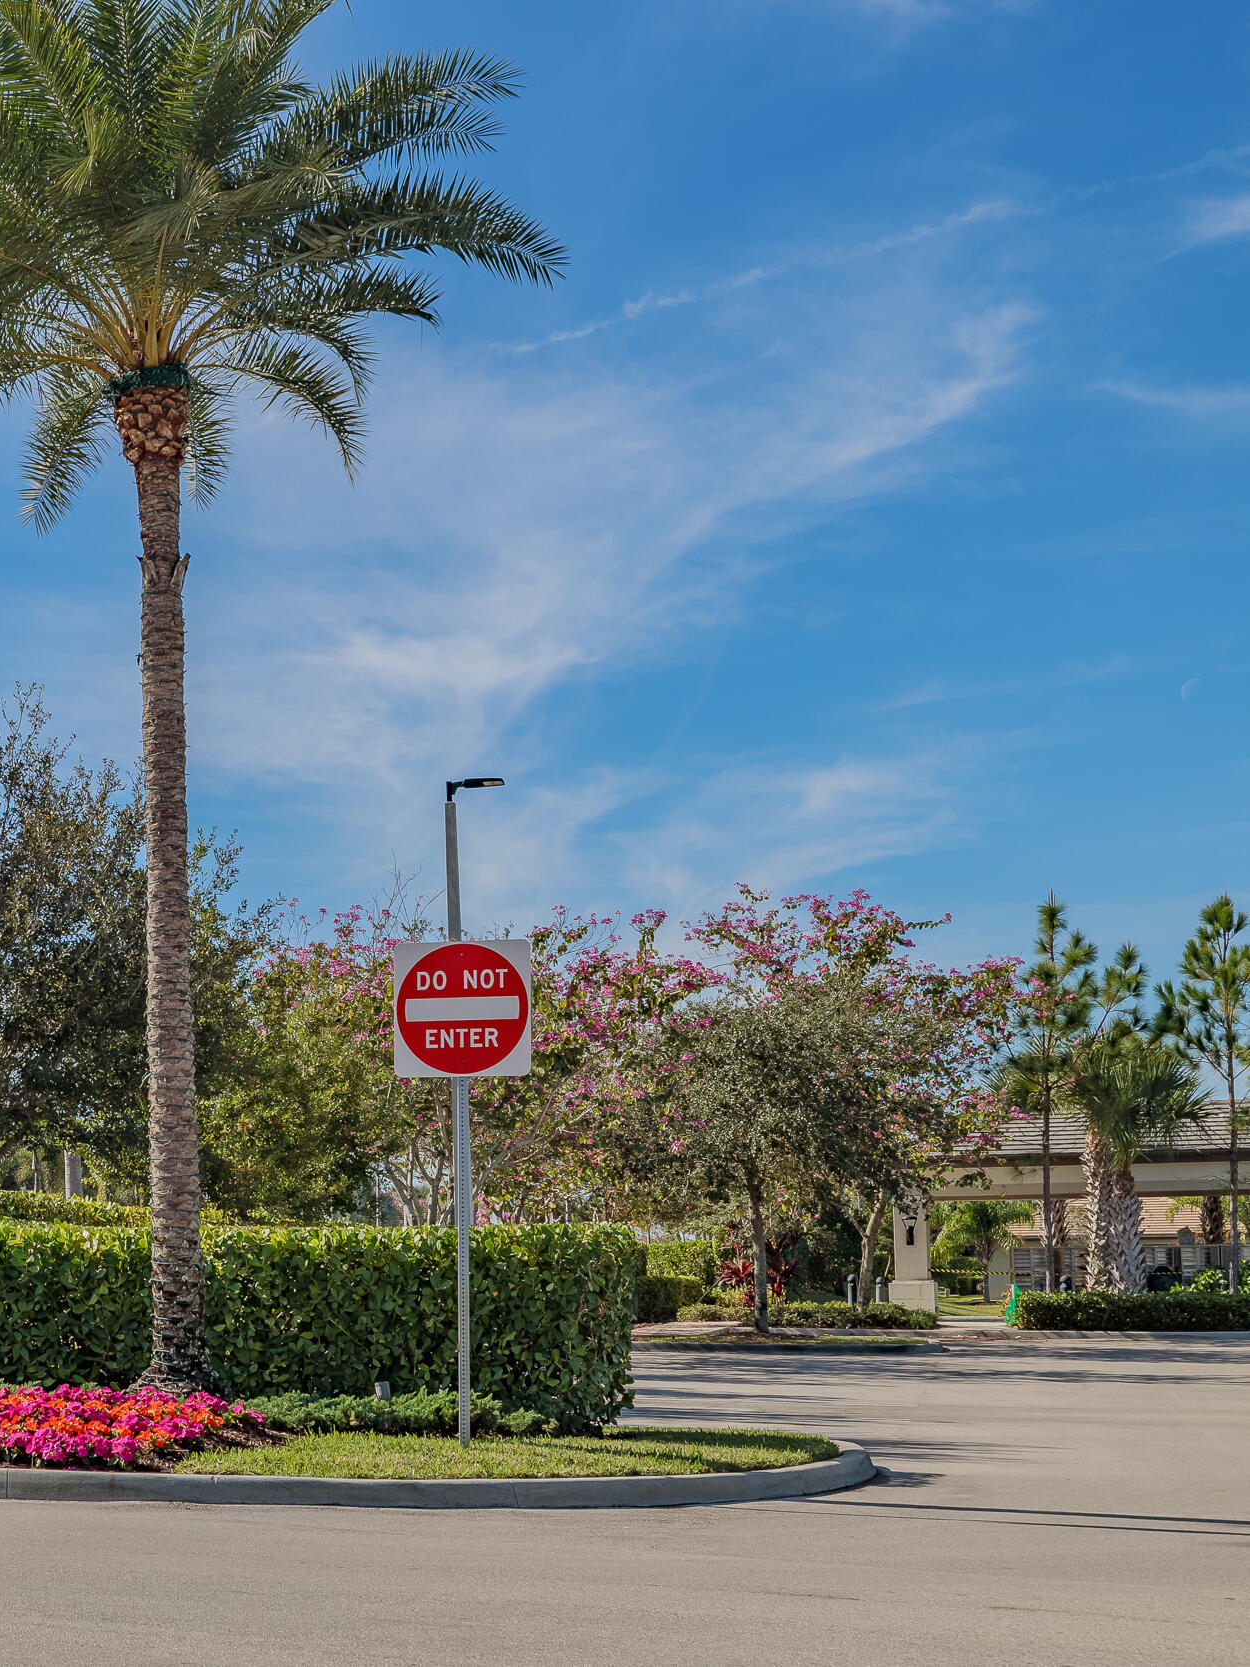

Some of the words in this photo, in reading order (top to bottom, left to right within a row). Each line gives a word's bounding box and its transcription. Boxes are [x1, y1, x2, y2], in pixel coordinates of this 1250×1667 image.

[416, 970, 447, 991] DO
[463, 968, 508, 990] NOT
[425, 1027, 499, 1049] ENTER
